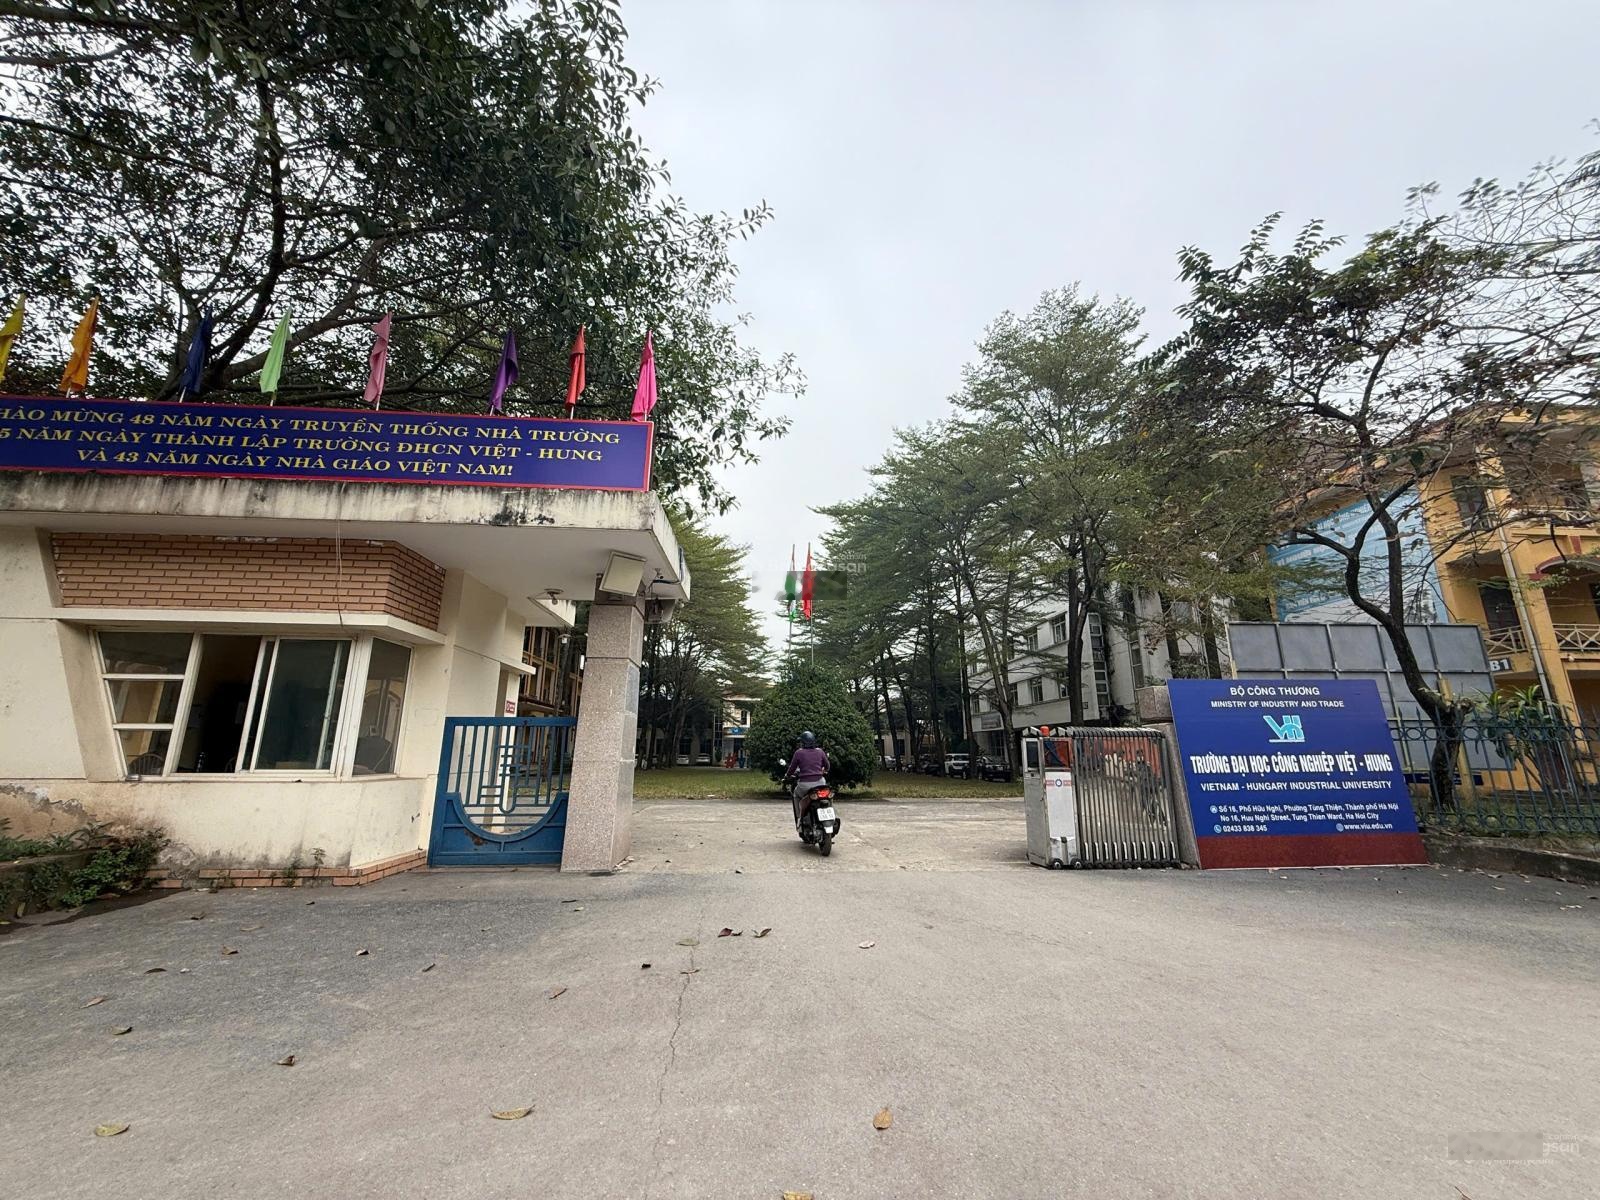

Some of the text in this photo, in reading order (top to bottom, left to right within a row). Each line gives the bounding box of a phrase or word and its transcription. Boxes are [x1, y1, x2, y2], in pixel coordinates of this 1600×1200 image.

[50, 408, 124, 424] MỪNG
[130, 414, 155, 425] 48
[160, 413, 214, 427] NĂM
[219, 415, 284, 430] NGÀY
[289, 417, 384, 433] TRUYỀN
[389, 421, 469, 437] THỐNG
[474, 426, 523, 440] NHÀ
[528, 428, 620, 444] TRƯỜNG
[16, 426, 73, 441] NĂM
[77, 428, 147, 443] NGÀY
[151, 431, 236, 447] THÀNH
[240, 434, 287, 450] LẬP
[293, 437, 391, 453] TRƯỜNG
[396, 442, 463, 455] ĐHCN
[468, 444, 521, 459] VIỆT
[538, 448, 603, 461] HUNG
[77, 447, 513, 476] VÀ 43 NĂM NGÀY NHÀ GIÁO VIỆT NAM!
[1489, 659, 1510, 672] B1
[1230, 685, 1320, 697] BỘ CÔNG THƯƠNG
[1211, 700, 1345, 708] MINISTRY OF INDUSTRY AND TRADE
[1190, 751, 1231, 774] TRƯỜNG
[1231, 755, 1249, 777] ĐẠI
[1249, 755, 1271, 777] HỌC
[1271, 751, 1300, 773] CÔNG
[1299, 751, 1335, 776] NGHIỆP
[1335, 750, 1358, 776] VIỆT
[1364, 754, 1394, 772] HUNG
[1200, 782, 1240, 792] VIETNAM
[1246, 782, 1288, 791] HUNGARY
[1290, 781, 1340, 790] INDUSTRIAL
[1342, 781, 1392, 789] UNIVERSITY
[1220, 814, 1230, 822] No
[1366, 812, 1379, 820] City
